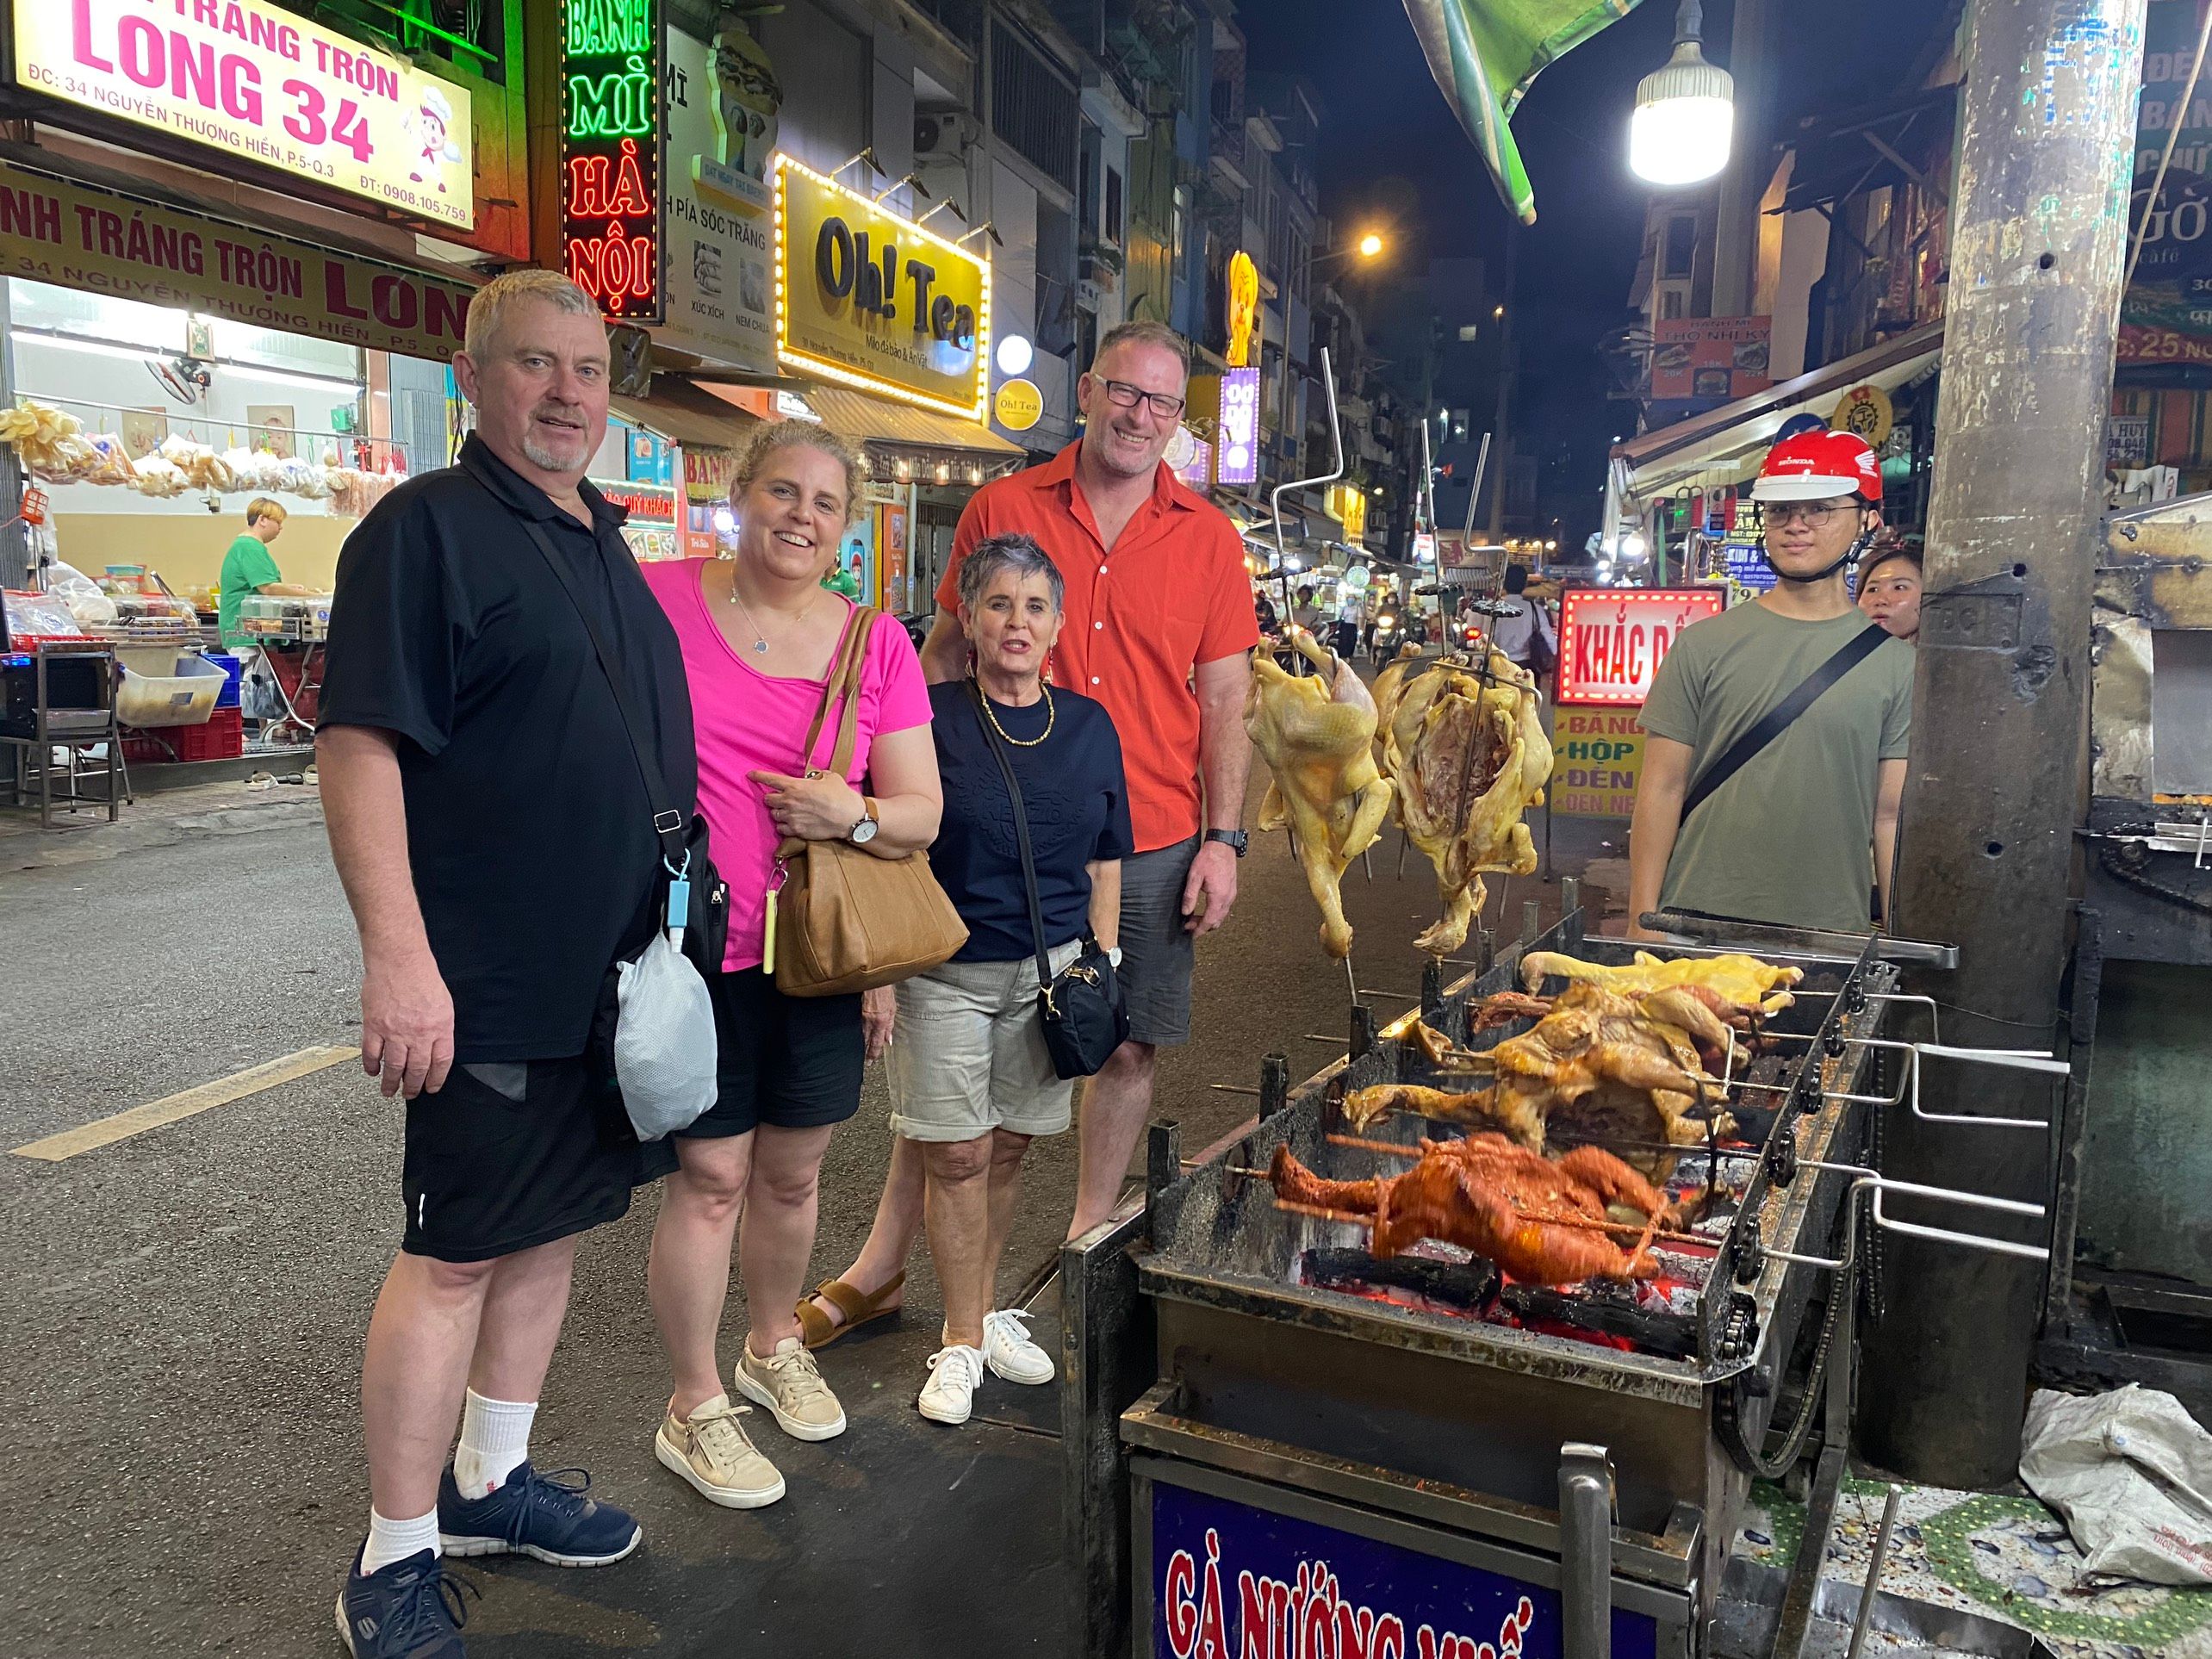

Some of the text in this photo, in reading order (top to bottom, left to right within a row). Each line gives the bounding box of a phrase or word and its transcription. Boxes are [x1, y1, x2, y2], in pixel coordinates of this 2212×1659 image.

[72, 0, 374, 164] LONG 34
[313, 38, 399, 103] TRỘN
[569, 55, 649, 136] MÌ
[28, 64, 59, 87] ĐC:
[65, 77, 87, 96] 34
[94, 86, 168, 123] NGUYỄN
[173, 112, 240, 147] THƯỢNG
[288, 151, 334, 177] P.5-Q.3
[360, 175, 466, 221] ĐT: 0908.105.759
[569, 138, 649, 215] HÀ
[74, 203, 204, 277] TRÁNG
[214, 239, 302, 301] TRỘN
[676, 197, 698, 224] PÍA
[700, 208, 725, 235] SÓC
[727, 221, 766, 252] TRĂNG
[569, 220, 649, 310] NỘI
[815, 216, 975, 352] Oh! Tea
[691, 300, 706, 315] XÚC
[735, 314, 751, 328] NEM
[1000, 399, 1037, 411] Oh! Tea
[643, 494, 674, 517] KHÁCH
[1575, 603, 1644, 684] KHẮC
[1568, 737, 1634, 764] HỘP
[1165, 1527, 1229, 1659] GÀ
